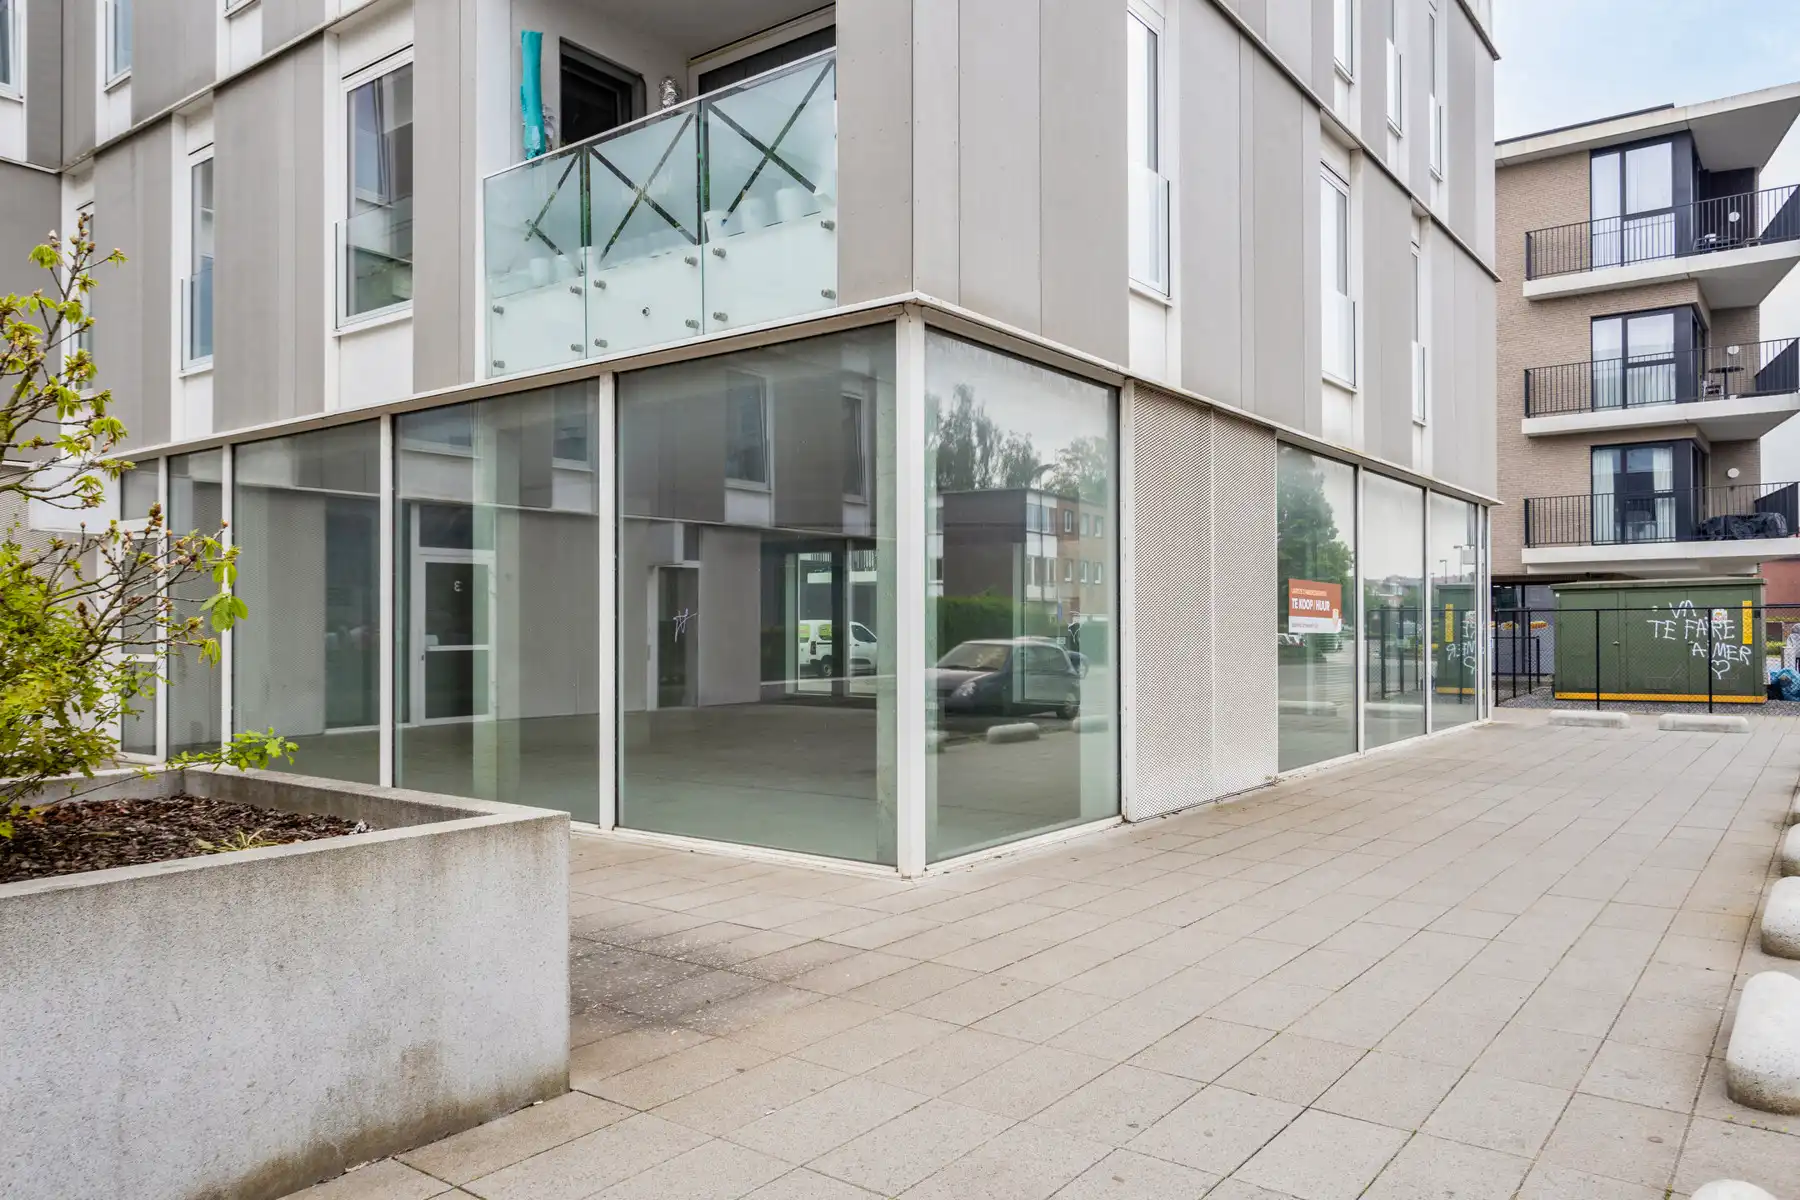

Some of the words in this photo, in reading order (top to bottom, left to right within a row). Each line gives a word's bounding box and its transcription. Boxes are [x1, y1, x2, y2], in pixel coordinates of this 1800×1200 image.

[1291, 597, 1299, 609] TE
[1299, 598, 1313, 610] KOOP
[1316, 599, 1330, 612] HUUR
[1668, 599, 1697, 619] VA
[1646, 619, 1677, 640] TE
